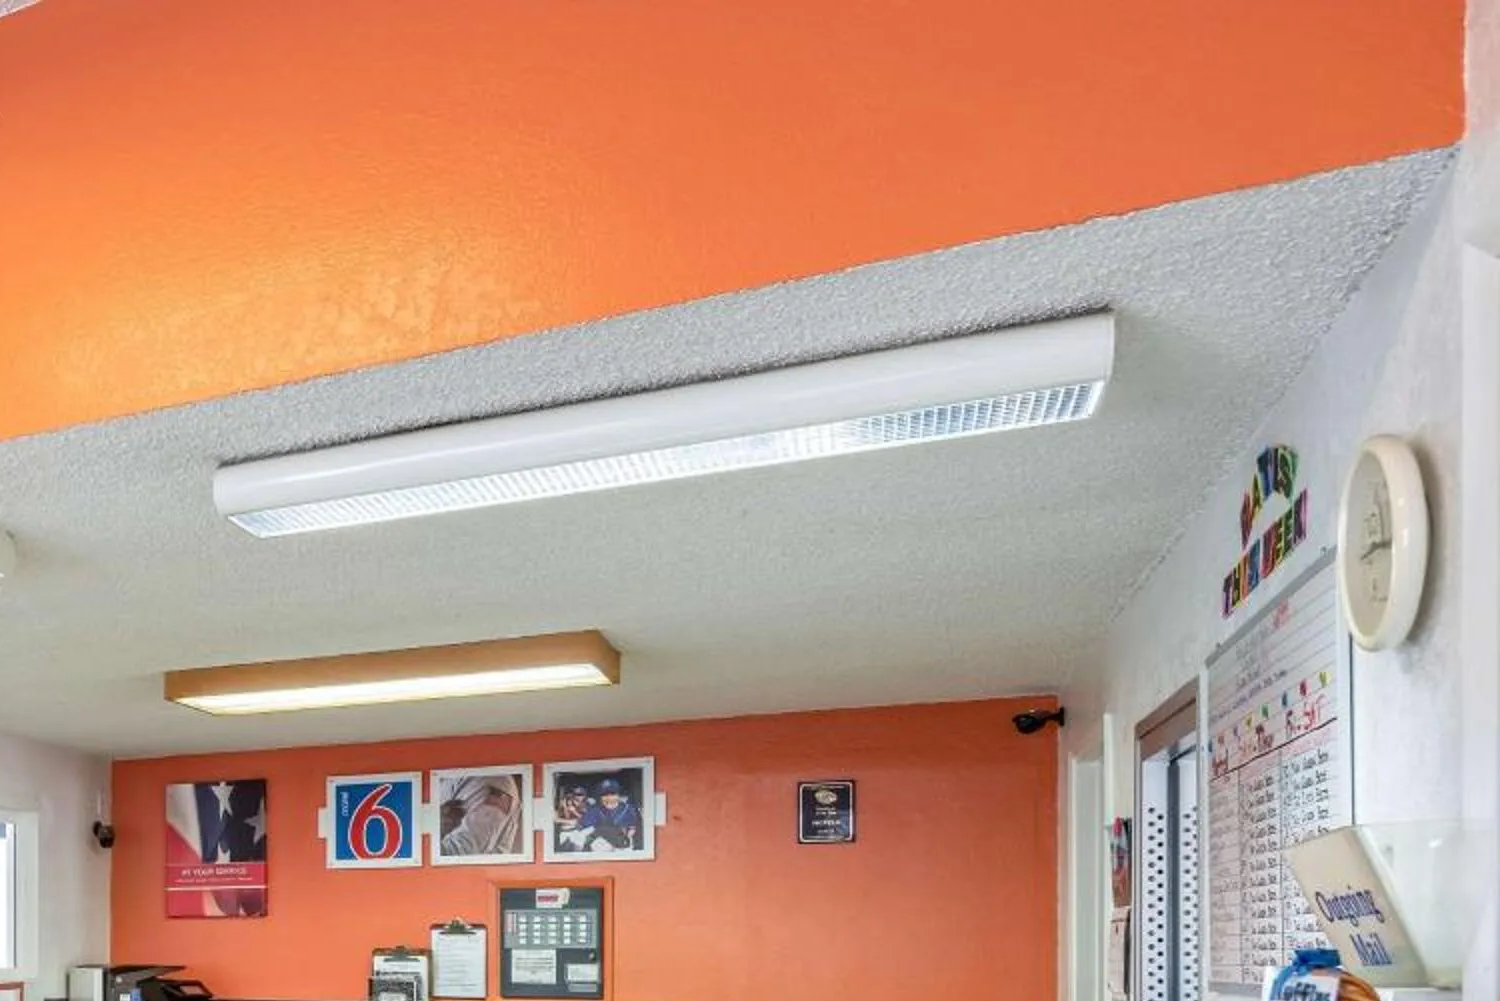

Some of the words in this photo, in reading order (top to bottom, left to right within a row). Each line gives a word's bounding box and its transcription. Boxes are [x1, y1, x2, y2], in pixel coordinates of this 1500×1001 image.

[1222, 538, 1261, 620] THIS
[348, 783, 403, 860] 6
[1315, 886, 1385, 927] Outgoing
[1349, 932, 1393, 967] Mail
